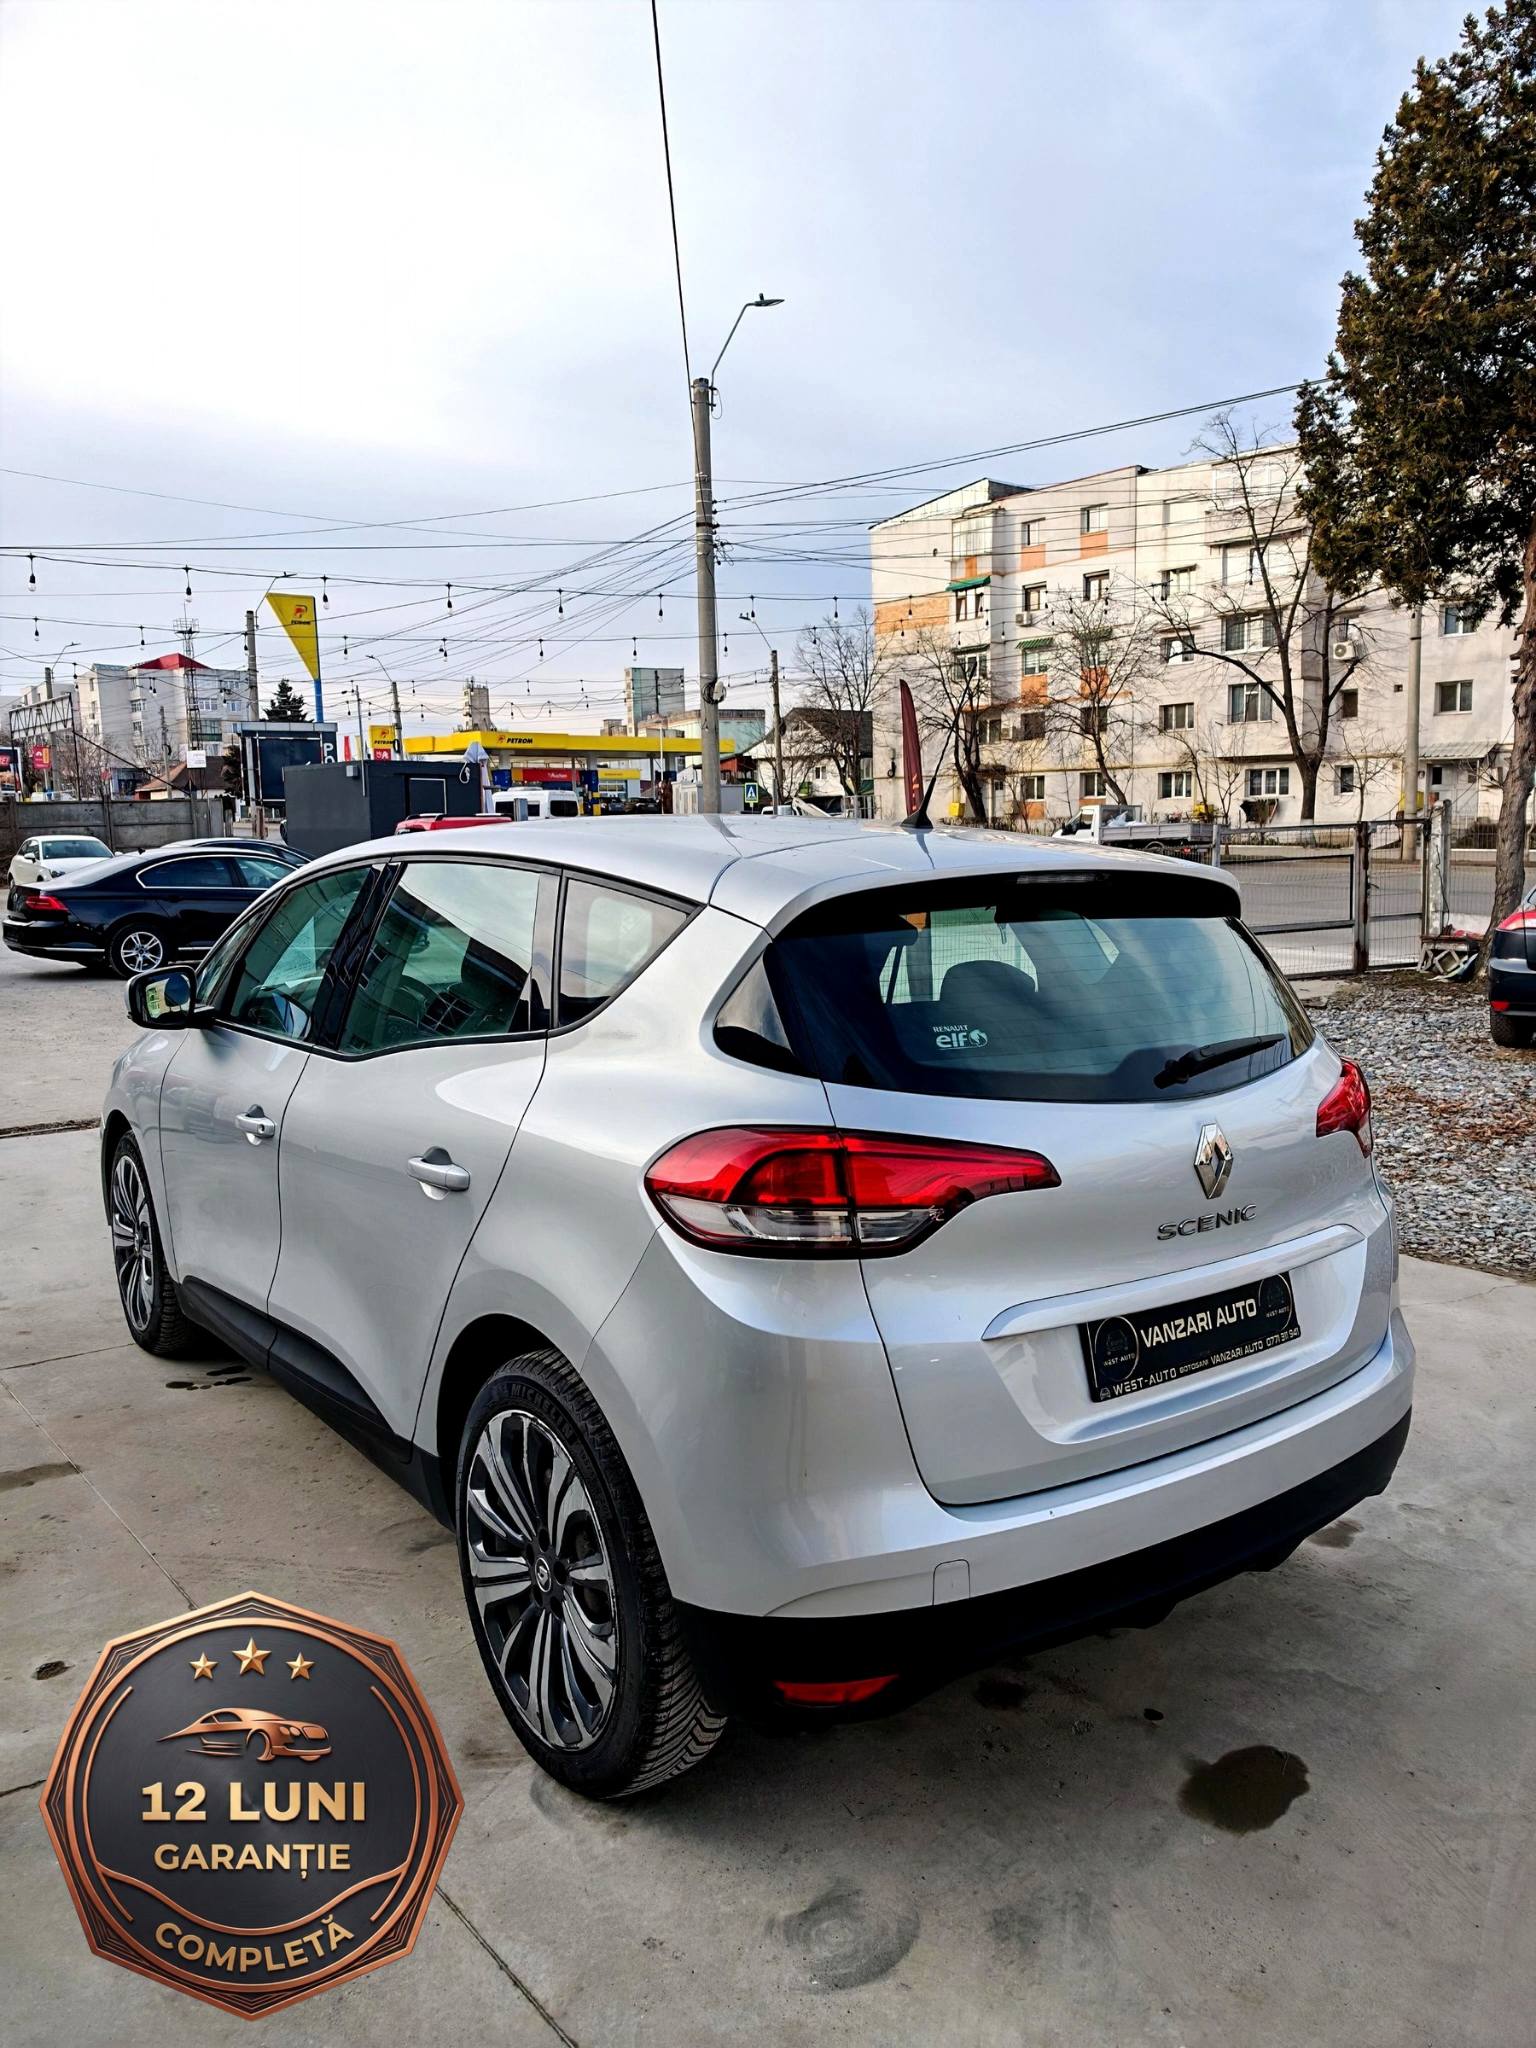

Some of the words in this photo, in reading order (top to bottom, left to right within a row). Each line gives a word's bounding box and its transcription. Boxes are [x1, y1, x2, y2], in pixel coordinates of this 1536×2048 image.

[933, 1024, 968, 1032] RENAULT
[936, 1032, 967, 1048] elf
[1157, 1203, 1257, 1241] SCENIC
[1140, 1311, 1213, 1348] VANZARI
[1216, 1298, 1257, 1327] AUTO
[1112, 1367, 1177, 1396] WEST-AUTO
[1210, 1347, 1243, 1365] VANZARI
[1244, 1340, 1263, 1354] AUTO
[511, 1383, 574, 1440] MICHELIN
